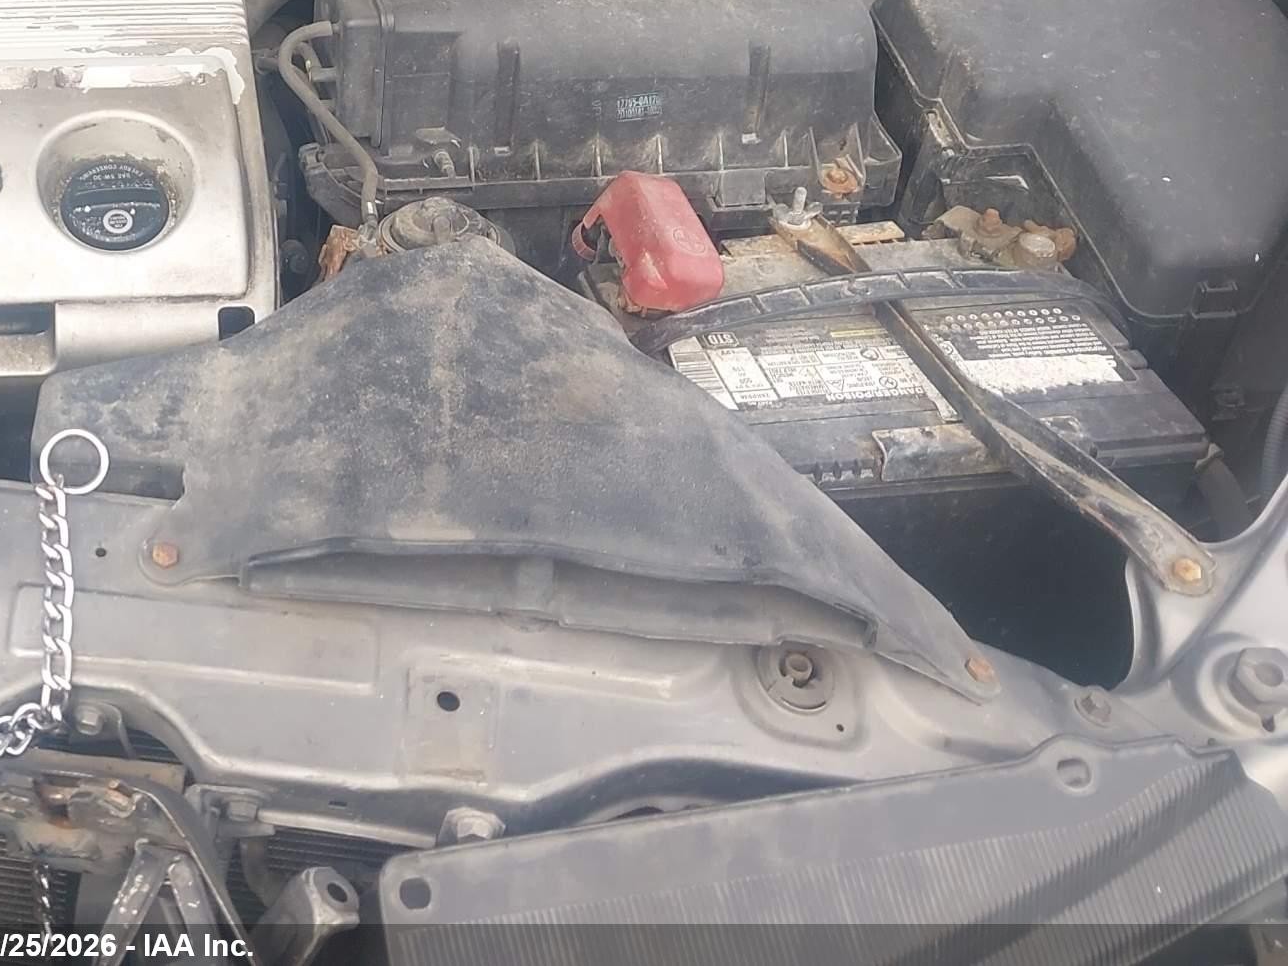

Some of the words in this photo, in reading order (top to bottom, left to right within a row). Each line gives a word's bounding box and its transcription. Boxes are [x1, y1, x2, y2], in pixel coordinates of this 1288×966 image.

[79, 164, 117, 181] CONSERVING
[119, 165, 144, 177] ENERGY
[707, 332, 736, 345] STD
[825, 386, 924, 402] DANGER/POISON
